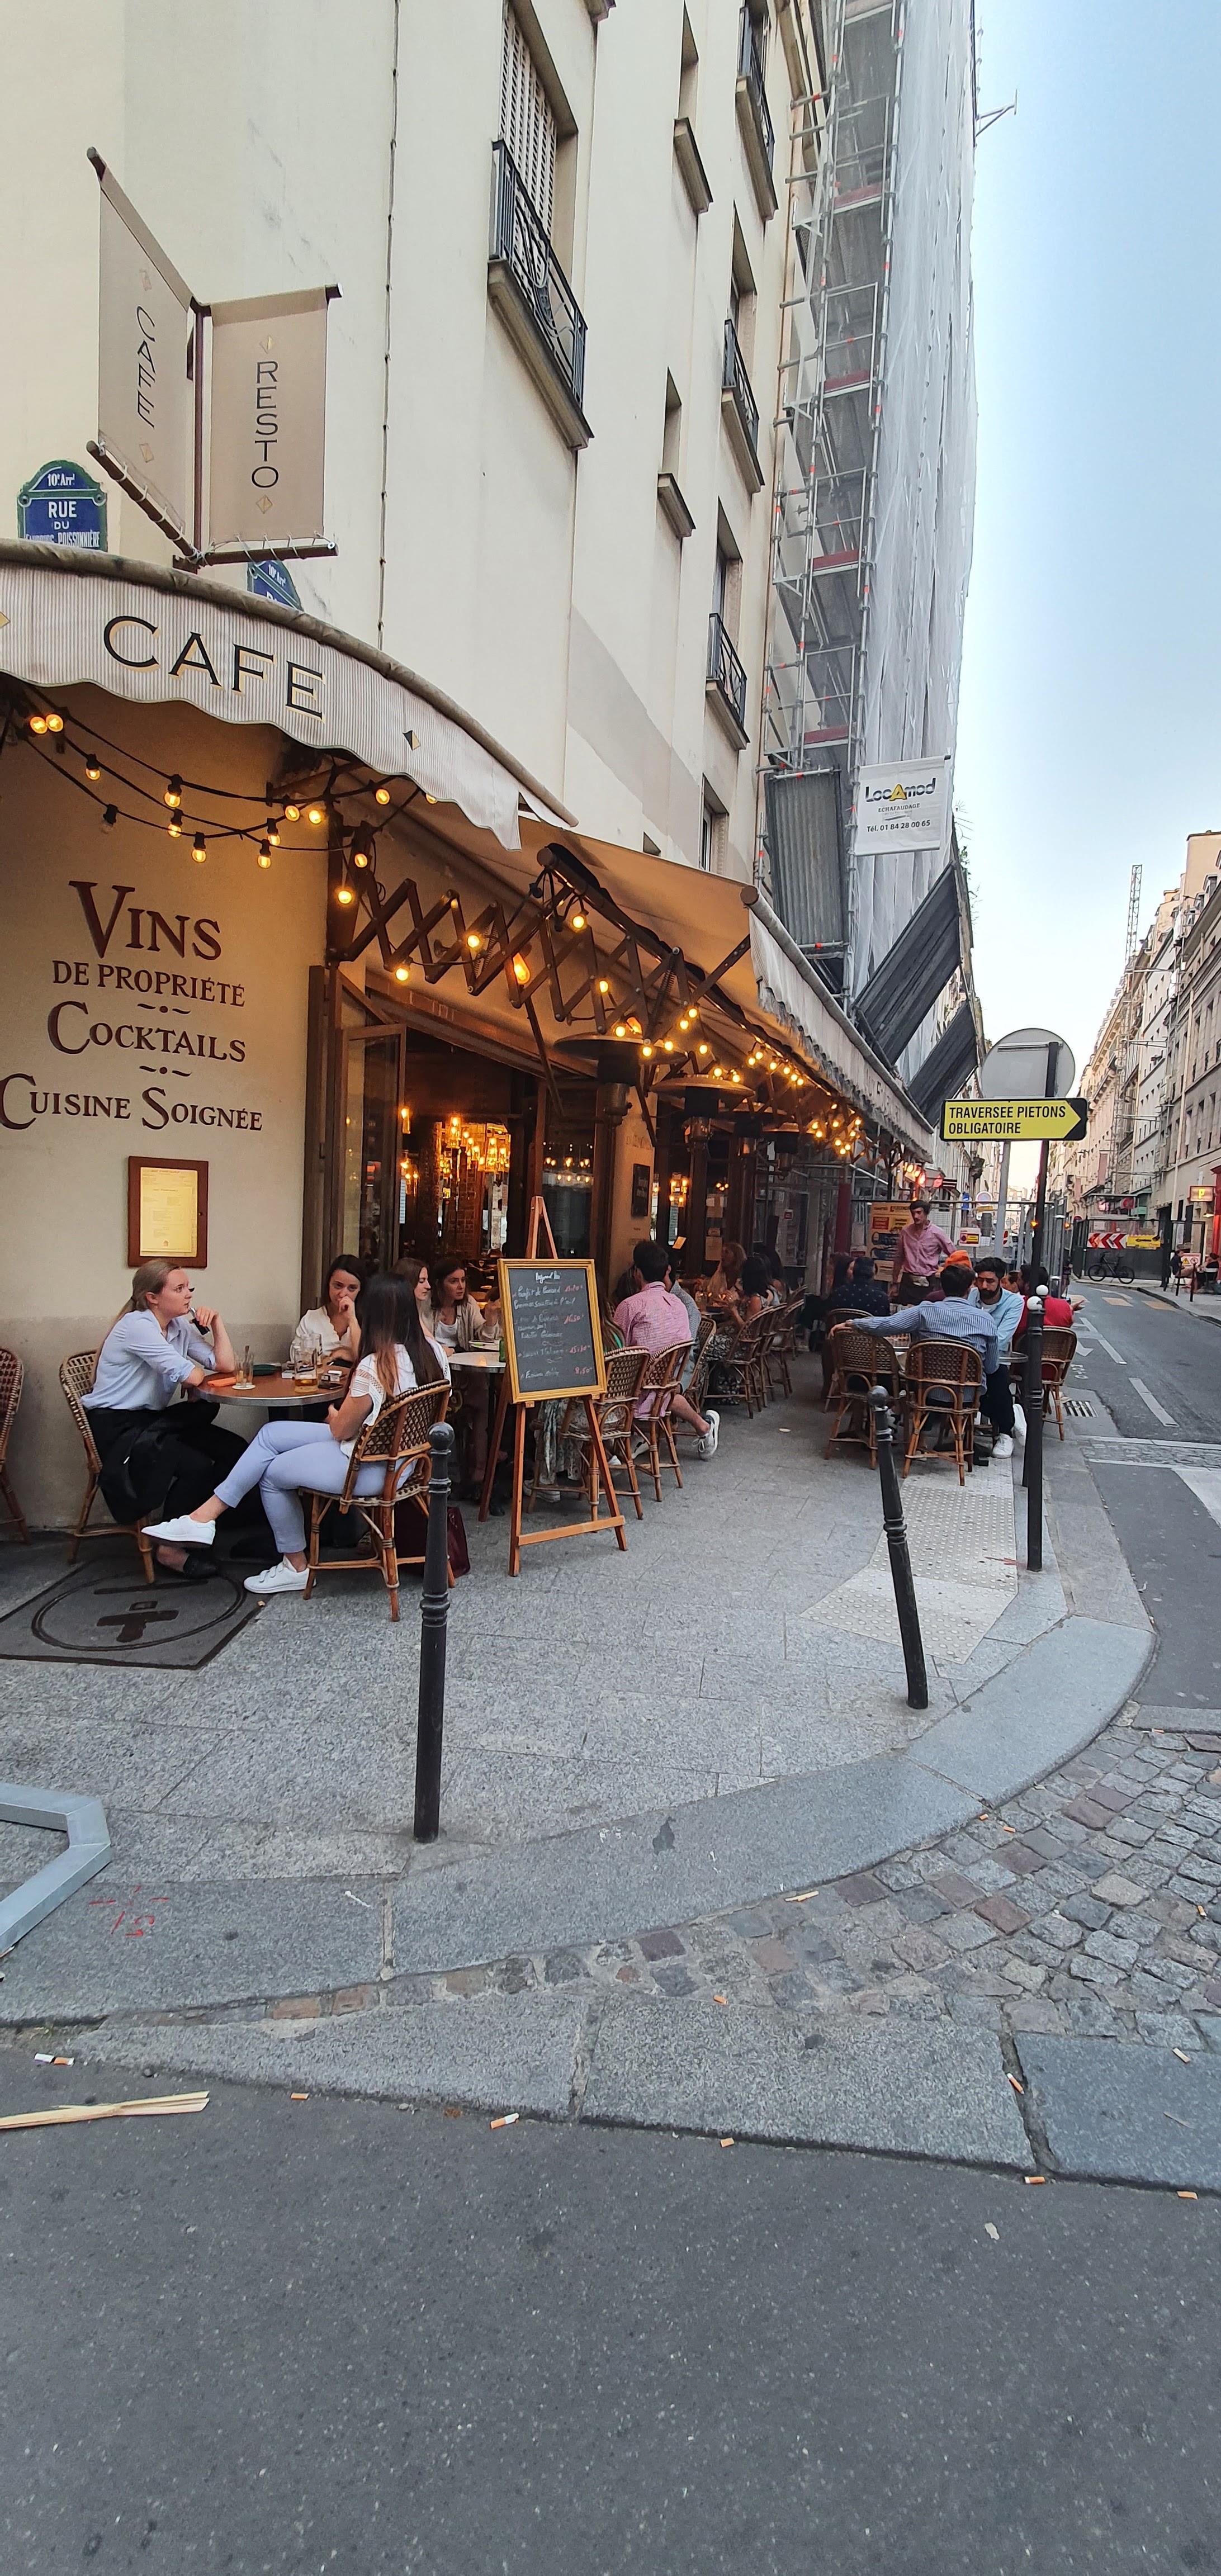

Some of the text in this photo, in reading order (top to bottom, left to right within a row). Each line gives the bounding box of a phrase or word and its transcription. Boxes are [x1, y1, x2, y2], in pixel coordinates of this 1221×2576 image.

[136, 306, 156, 429] CAFE
[252, 361, 279, 488] RESTO
[48, 501, 77, 518] RUE
[54, 521, 70, 530] DU
[103, 615, 326, 723] CAFE
[878, 803, 920, 813] ECHAFAUDAGE
[53, 959, 246, 1007] DE PROPRIÉTÉ
[949, 1105, 1066, 1119] TRAVERSEE PIETONS
[948, 1122, 1021, 1134] OBLIGATOIRE
